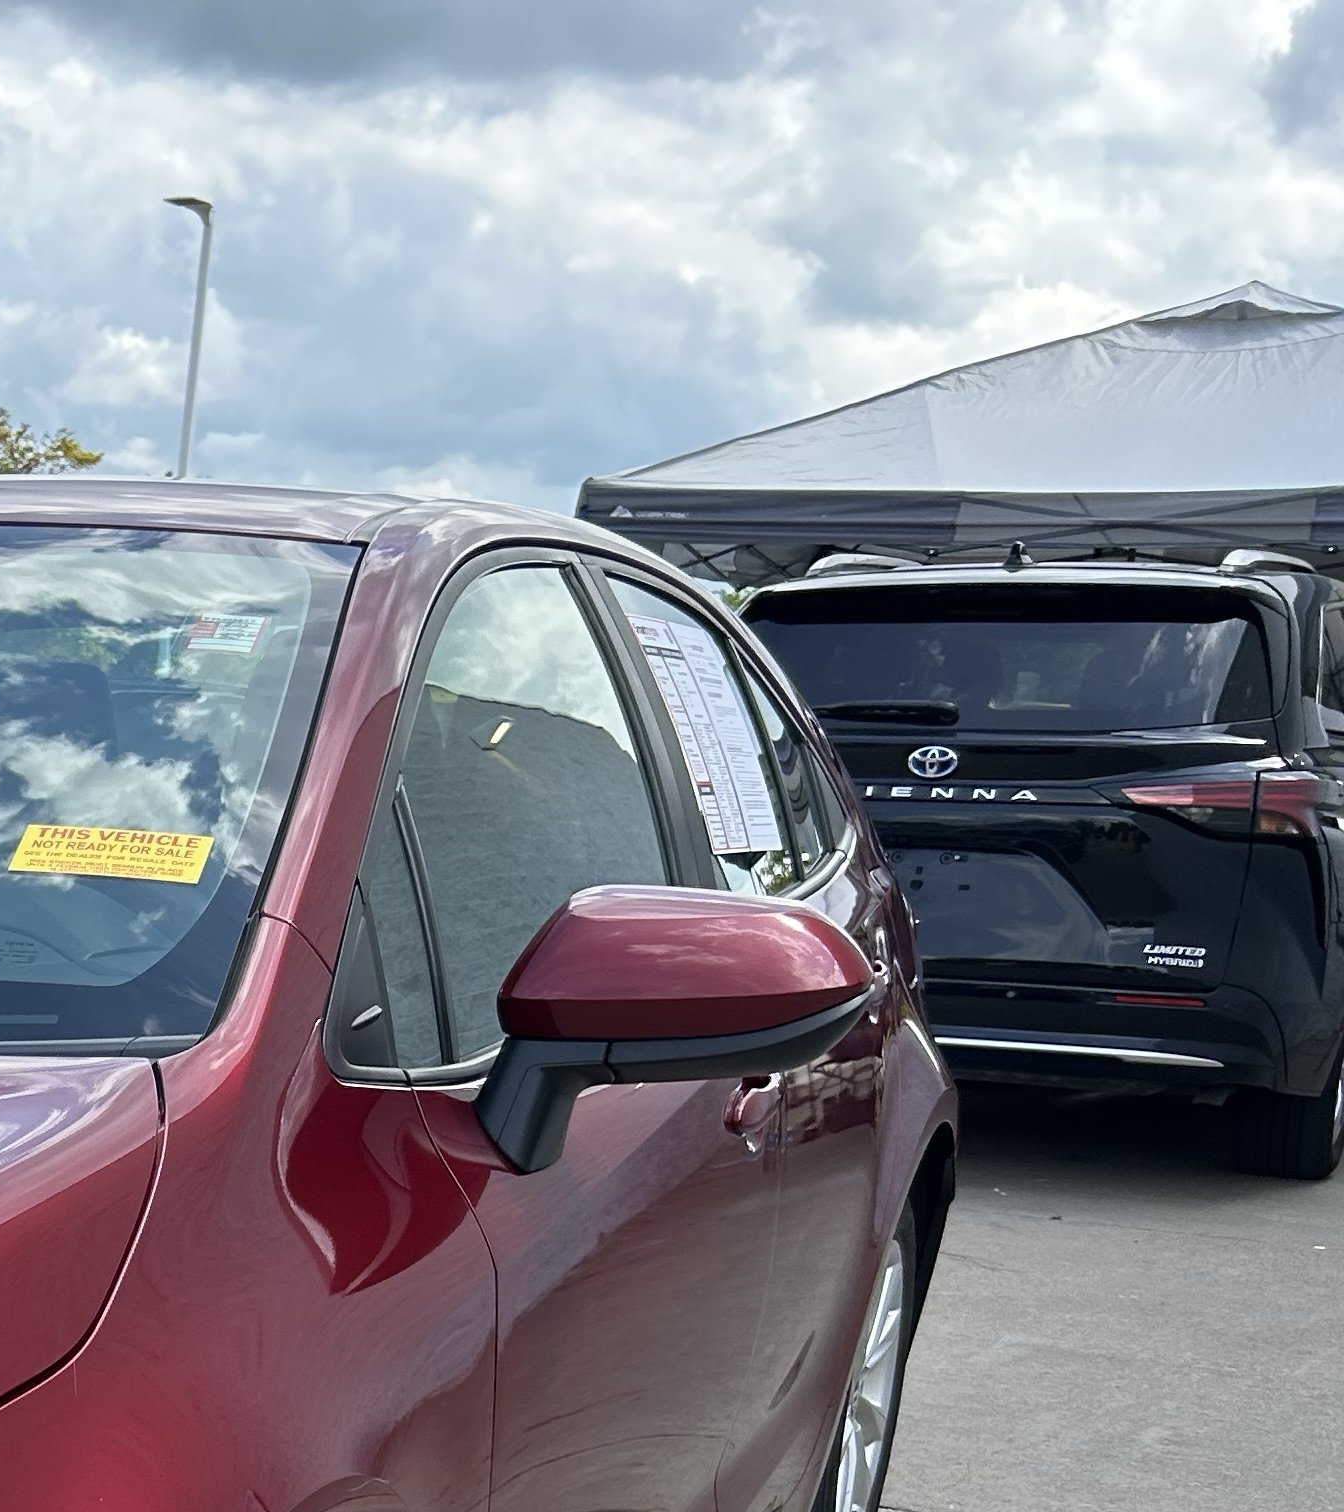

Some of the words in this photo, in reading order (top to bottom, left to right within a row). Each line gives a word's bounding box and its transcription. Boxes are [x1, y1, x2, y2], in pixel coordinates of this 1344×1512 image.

[864, 785, 1038, 801] IENNA
[37, 827, 91, 840] THIS
[99, 830, 202, 849] VEHICLE
[31, 839, 64, 850] NOT
[65, 841, 118, 852] READY
[119, 844, 152, 855] FOR
[154, 847, 196, 859] SALE
[170, 860, 196, 868] DATE
[1142, 944, 1206, 957] LIMITED
